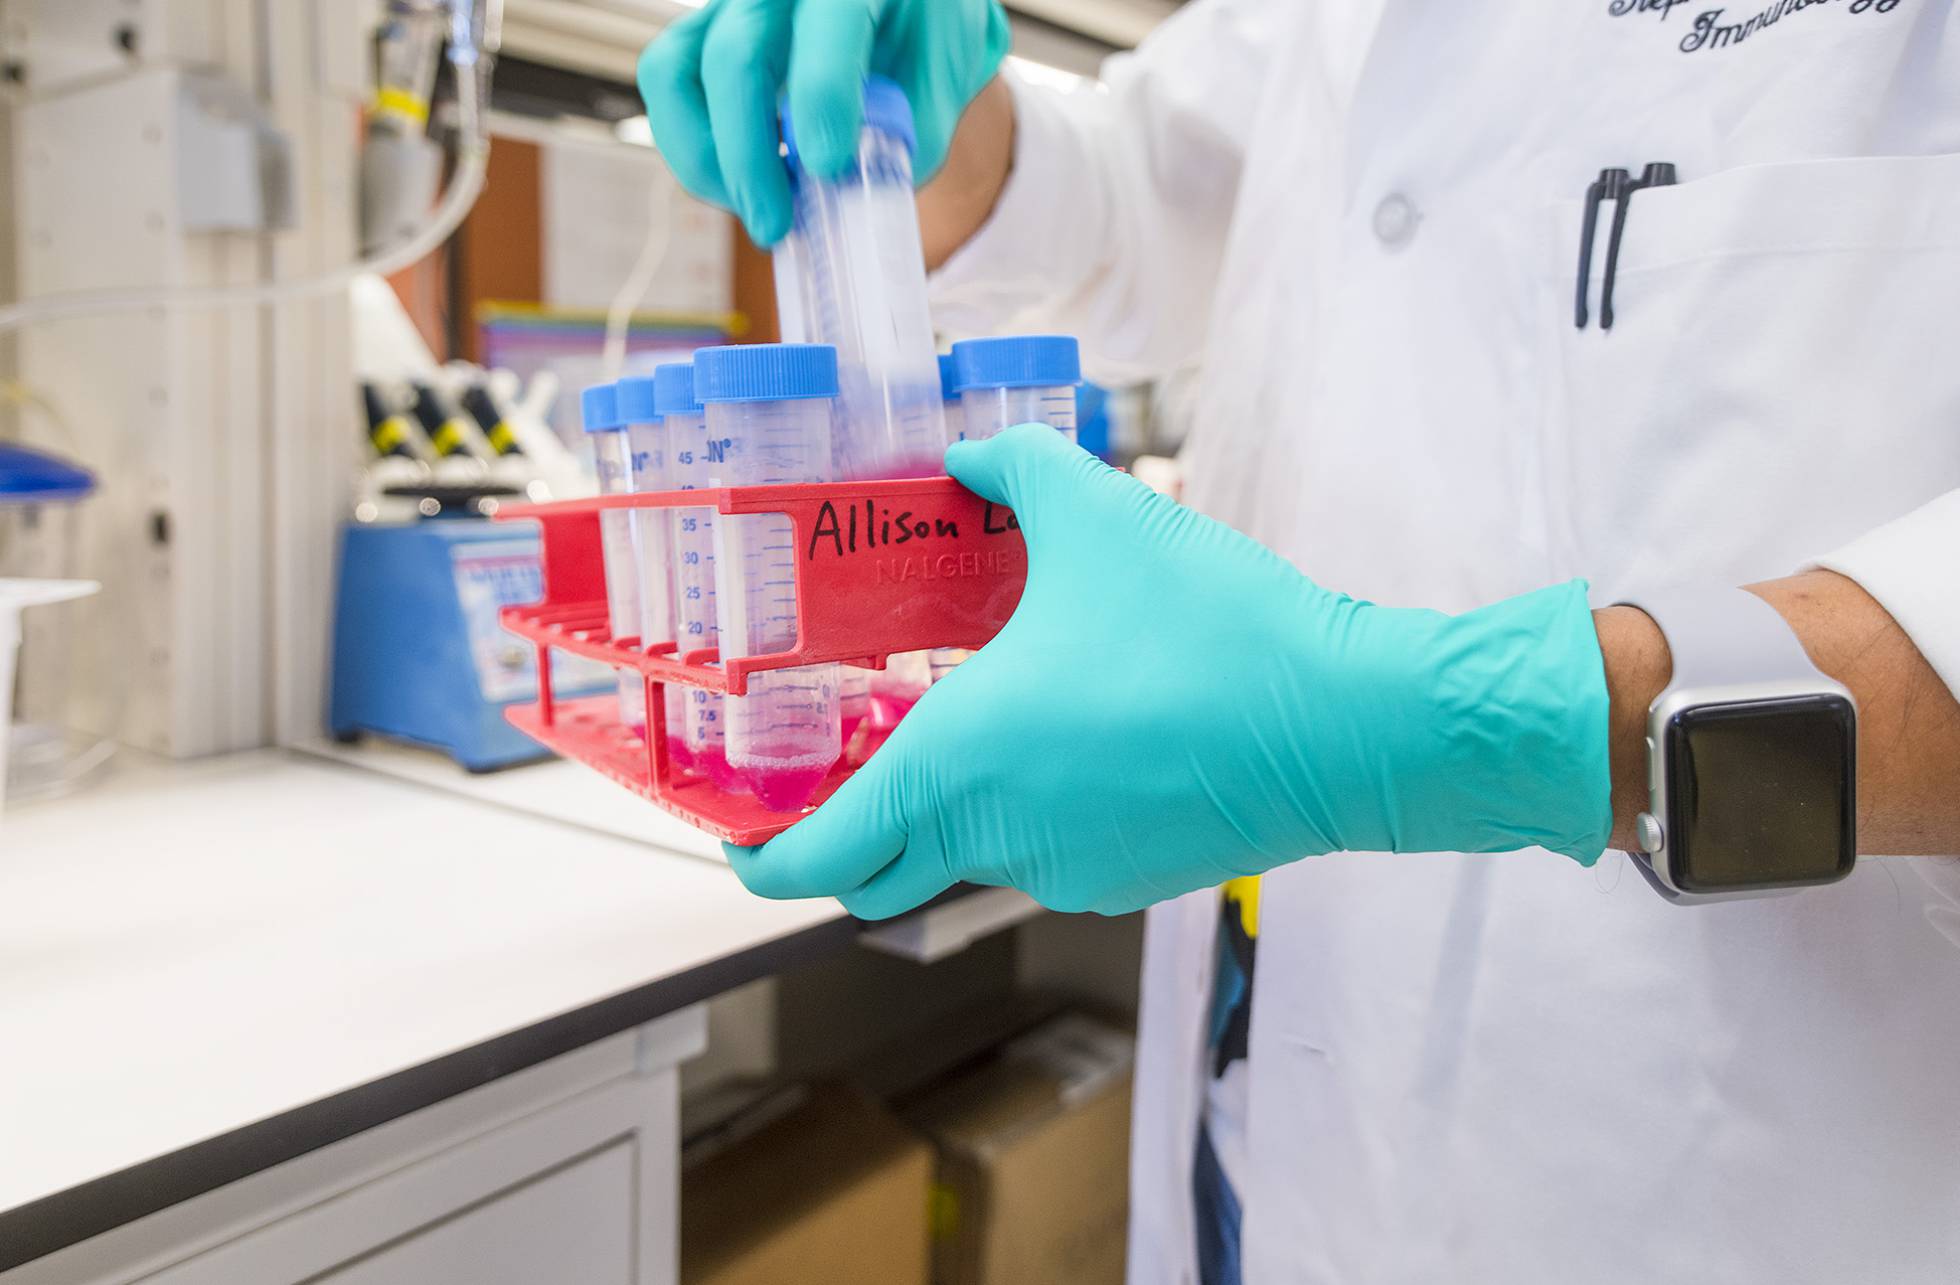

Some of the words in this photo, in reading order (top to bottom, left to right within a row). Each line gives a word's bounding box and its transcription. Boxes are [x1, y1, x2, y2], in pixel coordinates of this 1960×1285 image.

[679, 452, 693, 465] 45
[682, 519, 697, 531] 35
[809, 499, 959, 560] Allison
[684, 552, 699, 564] 30
[687, 587, 700, 599] 25
[688, 622, 703, 634] 20
[693, 690, 706, 703] 10
